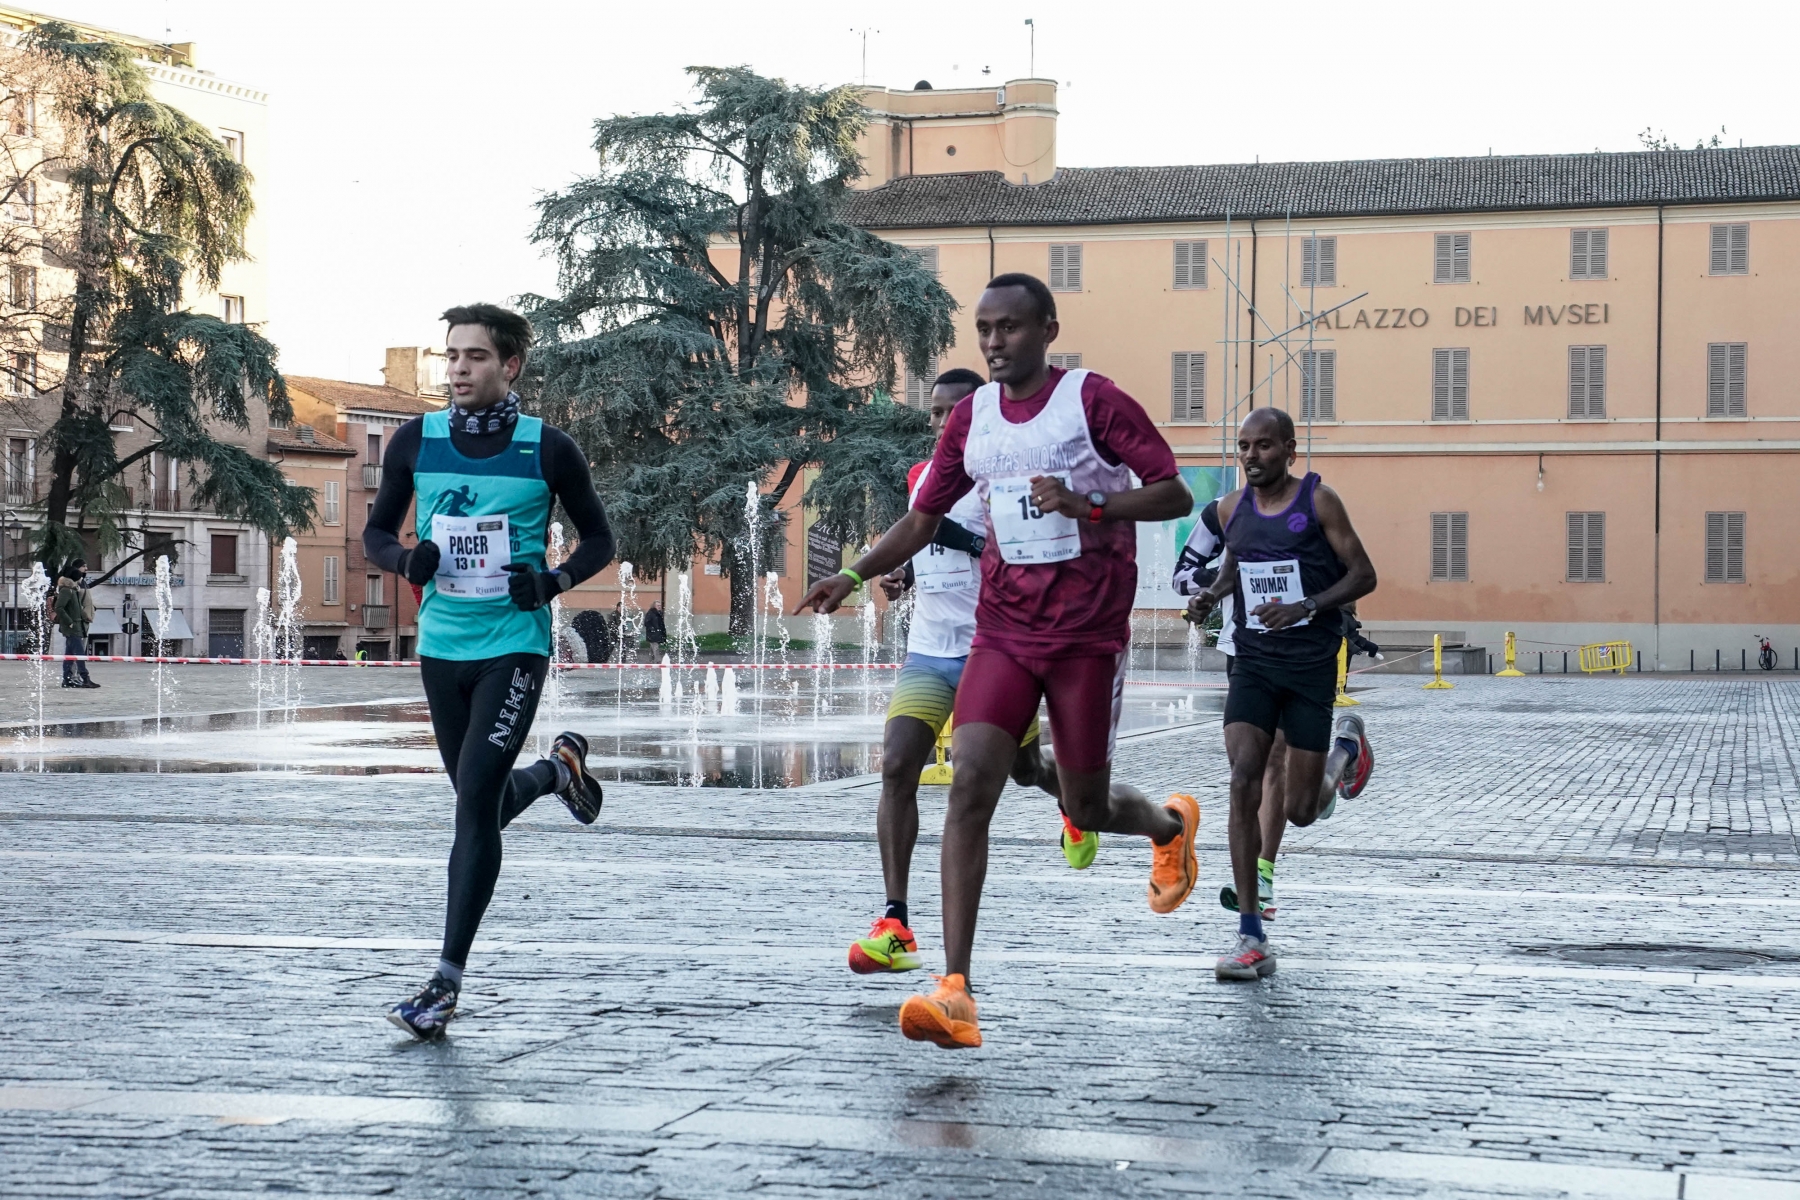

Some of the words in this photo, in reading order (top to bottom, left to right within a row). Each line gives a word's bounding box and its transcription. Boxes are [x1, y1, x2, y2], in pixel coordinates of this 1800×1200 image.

[1299, 307, 1429, 330] PALAZZO
[1454, 306, 1497, 327] DEI
[1524, 303, 1609, 326] MVSEI
[1023, 441, 1078, 471] LIVORNO
[449, 535, 489, 555] PACER
[930, 543, 945, 556] 14
[1042, 547, 1074, 559] Riunite
[454, 557, 468, 570] 13
[475, 585, 505, 595] Riunite
[941, 580, 968, 590] Riunite
[1249, 576, 1288, 594] SHUMAY
[488, 667, 530, 747] NIKE
